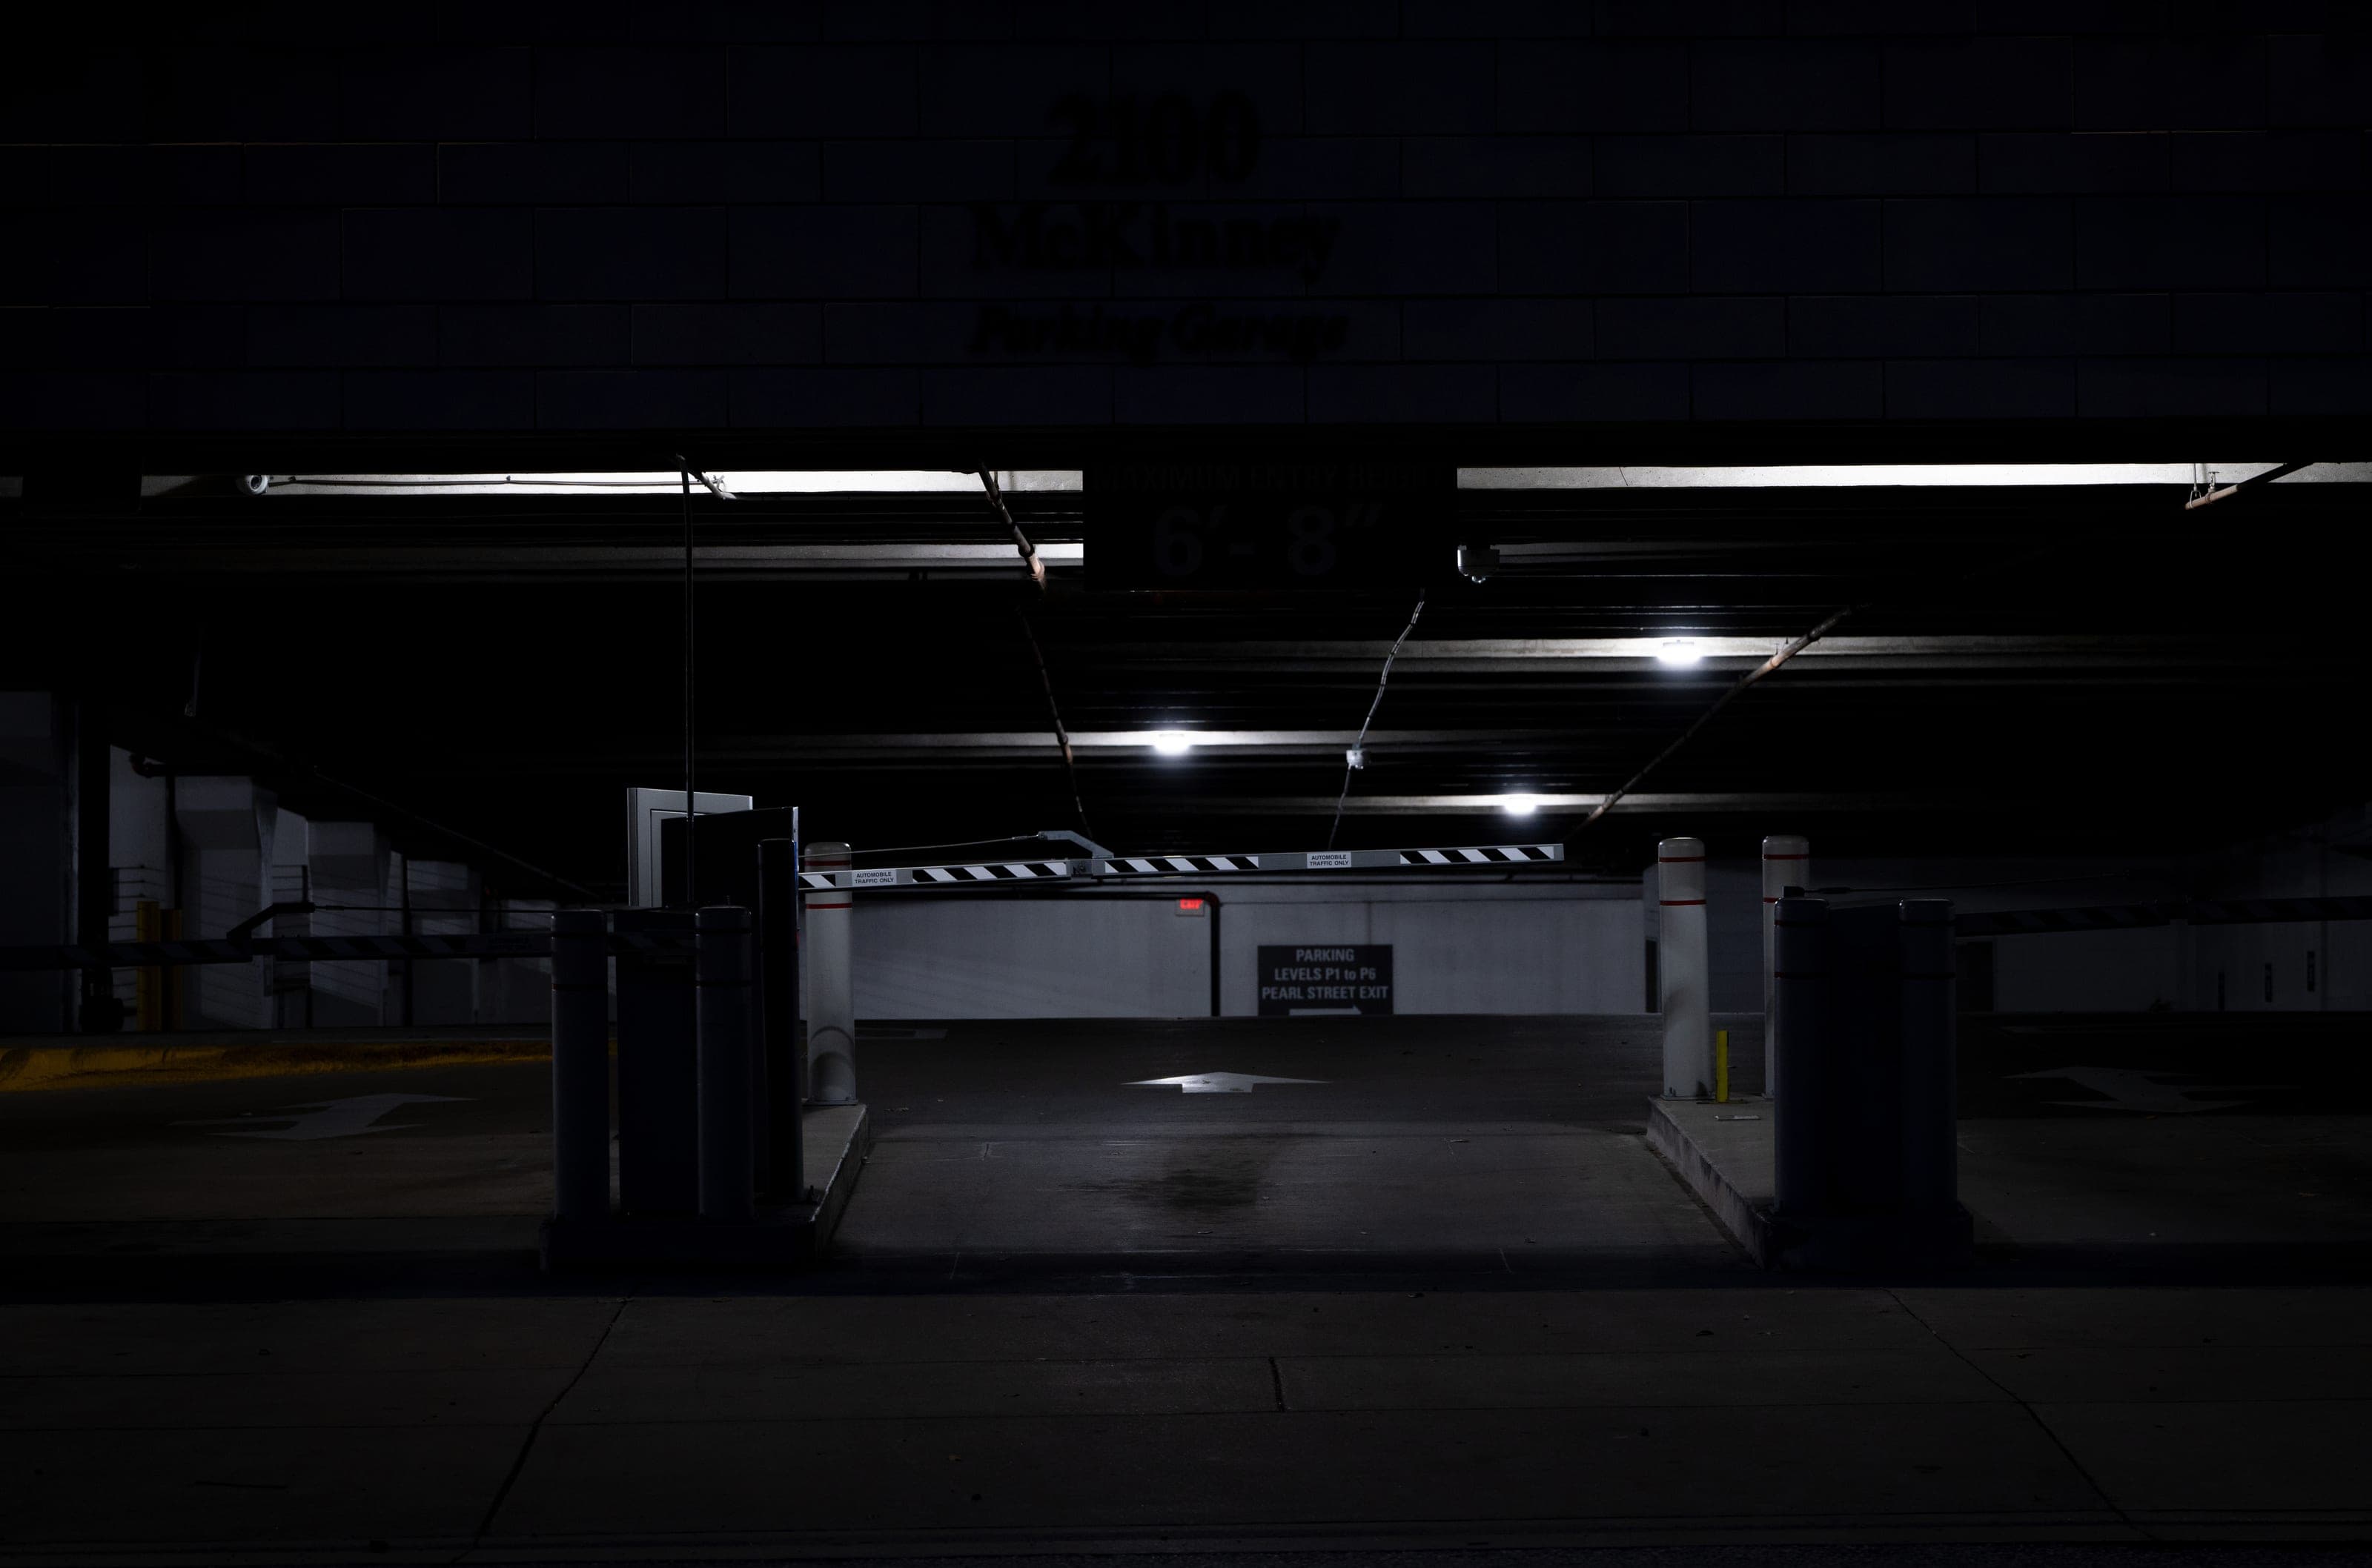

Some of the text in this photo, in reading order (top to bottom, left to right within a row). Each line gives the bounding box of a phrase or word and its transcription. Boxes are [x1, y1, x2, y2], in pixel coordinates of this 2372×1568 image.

[1049, 92, 1260, 187] 2100
[970, 202, 1340, 286] McKinney
[970, 302, 1349, 367] Parking Garage
[1273, 966, 1377, 981] LEVELS P1 to P6
[1296, 948, 1355, 963] PARKING
[1262, 985, 1389, 1000] PEARL STREET EXIT
